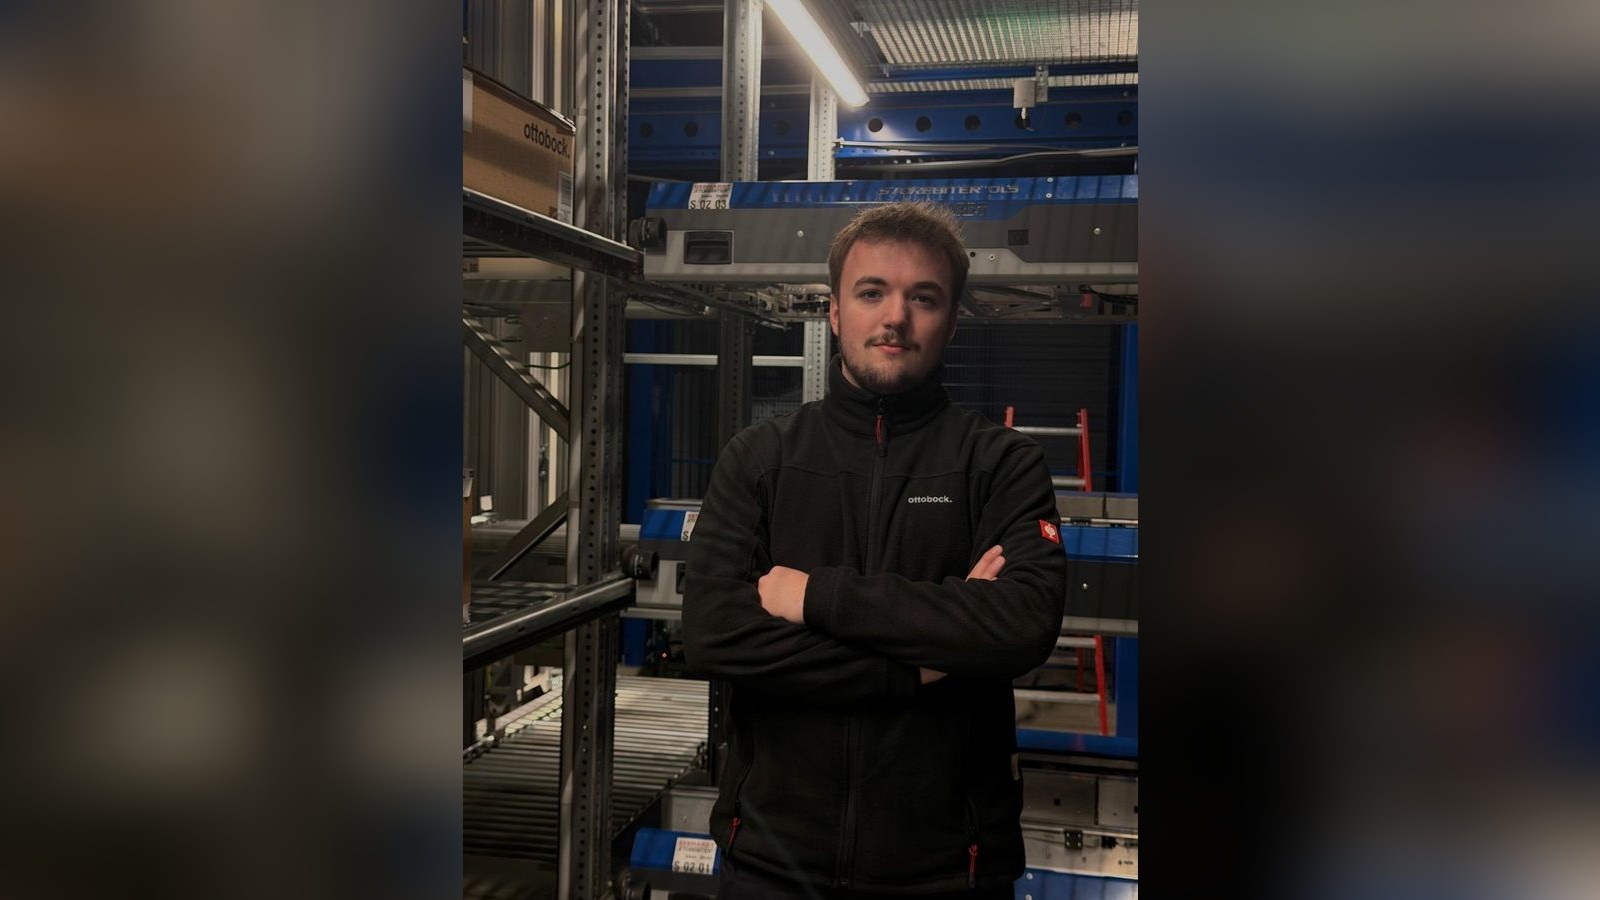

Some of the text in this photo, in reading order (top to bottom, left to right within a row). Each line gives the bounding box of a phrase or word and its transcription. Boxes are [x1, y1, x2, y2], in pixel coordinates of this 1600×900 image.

[523, 122, 571, 159] ottobock.
[690, 200, 727, 210] S 02 03
[907, 495, 953, 504] ottobock.
[673, 860, 681, 871] S
[683, 861, 696, 873] 02
